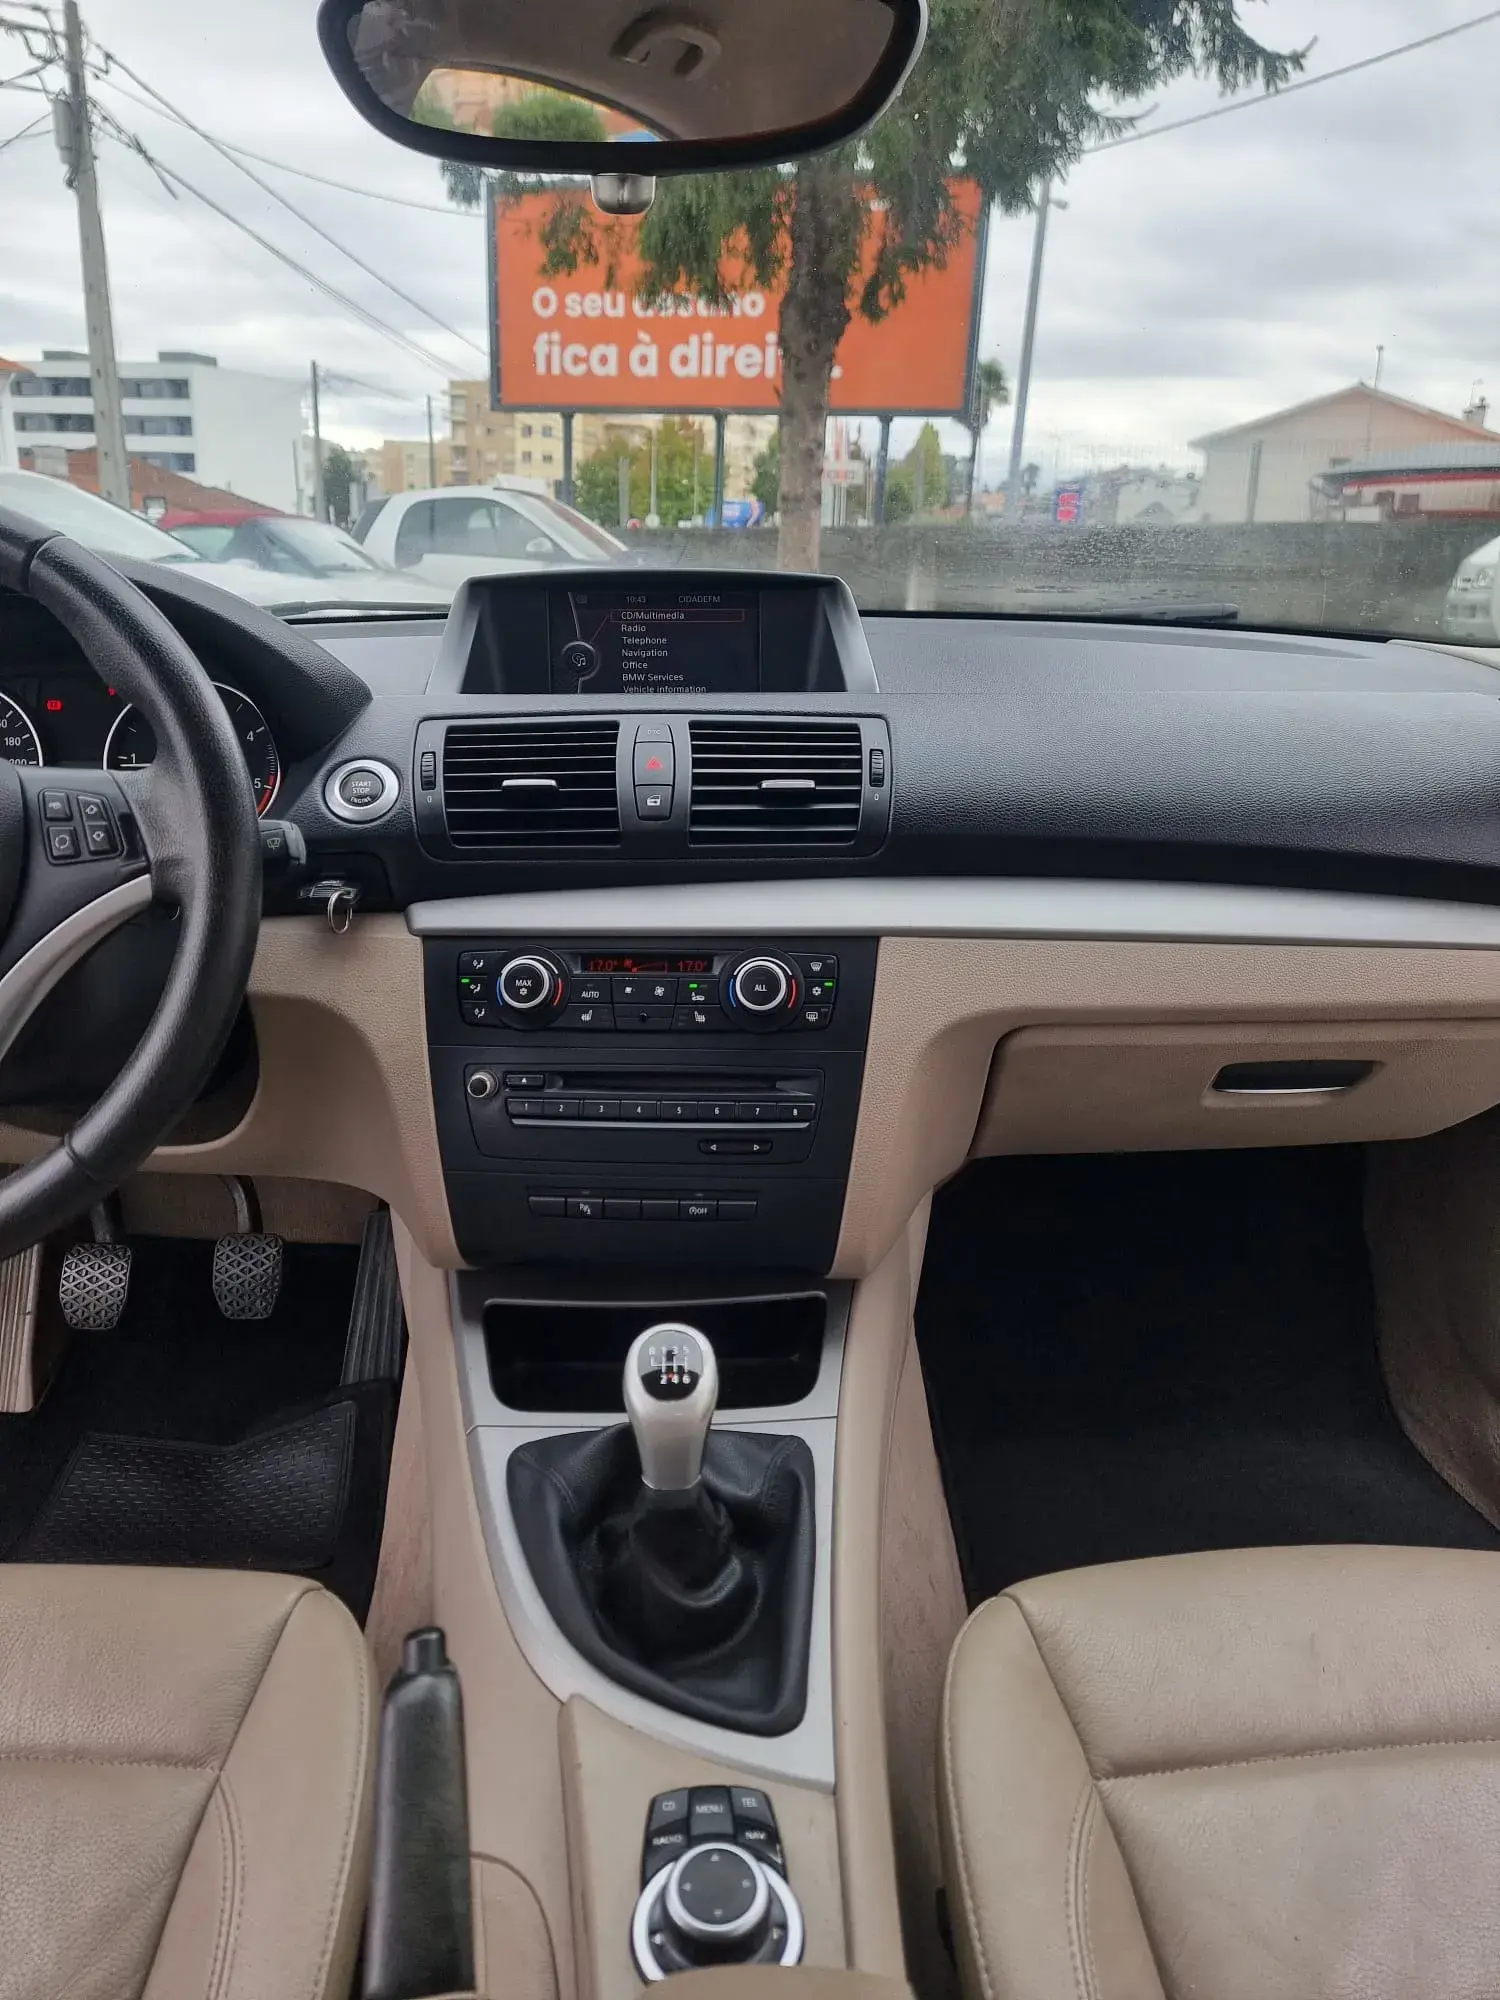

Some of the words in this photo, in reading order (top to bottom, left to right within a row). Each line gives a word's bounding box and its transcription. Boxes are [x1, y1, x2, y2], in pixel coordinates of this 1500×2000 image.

[532, 286, 558, 318] O
[564, 292, 626, 318] seu
[533, 331, 618, 376] fica
[629, 329, 659, 377] à
[621, 612, 684, 620] CD/Multimedia
[621, 624, 646, 632] Radio
[622, 636, 667, 646] Telephone
[622, 649, 668, 658] Navigation
[4, 736, 21, 746] 180
[246, 731, 254, 742] 4
[130, 753, 136, 764] 1
[254, 778, 262, 788] 5
[660, 1374, 668, 1384] 2
[672, 1374, 680, 1384] 4
[682, 1374, 690, 1384] 6
[696, 1804, 724, 1814] MENU
[653, 1834, 683, 1845] RADIO
[746, 1832, 766, 1840] NAV
